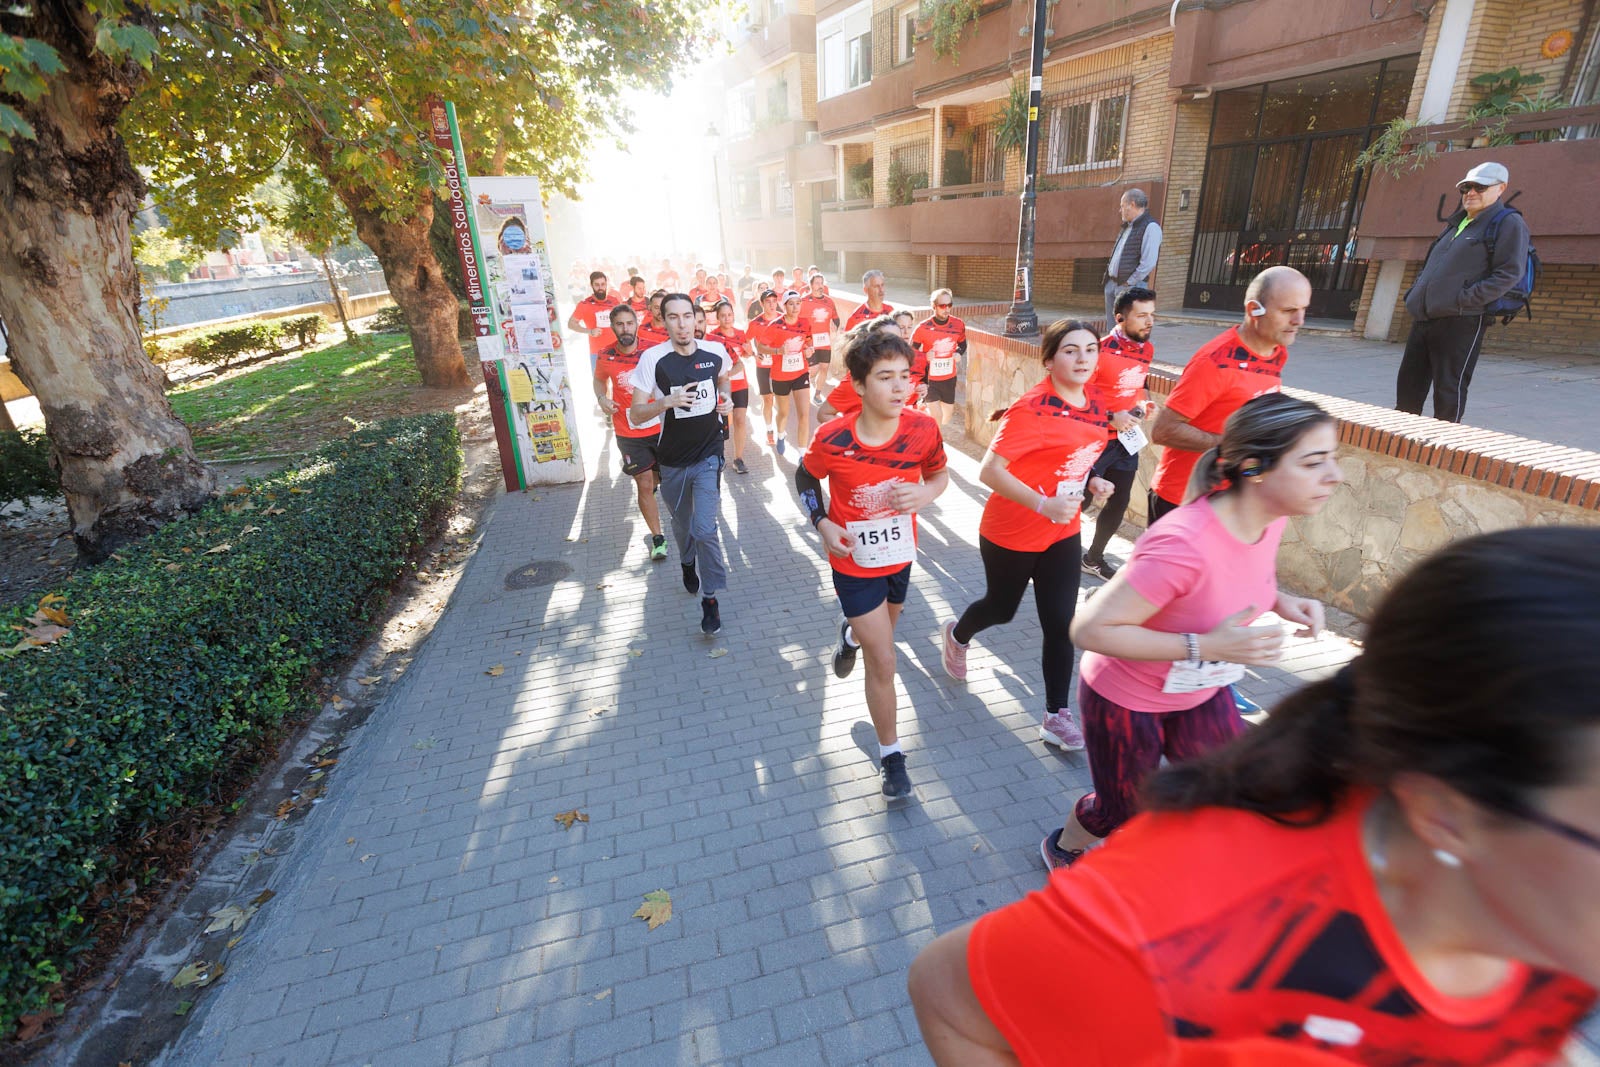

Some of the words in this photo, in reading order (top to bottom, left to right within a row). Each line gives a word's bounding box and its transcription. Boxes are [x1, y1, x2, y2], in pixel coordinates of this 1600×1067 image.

[1306, 115, 1316, 130] 2
[460, 232, 482, 299] tinerarios
[858, 526, 901, 546] 1515
